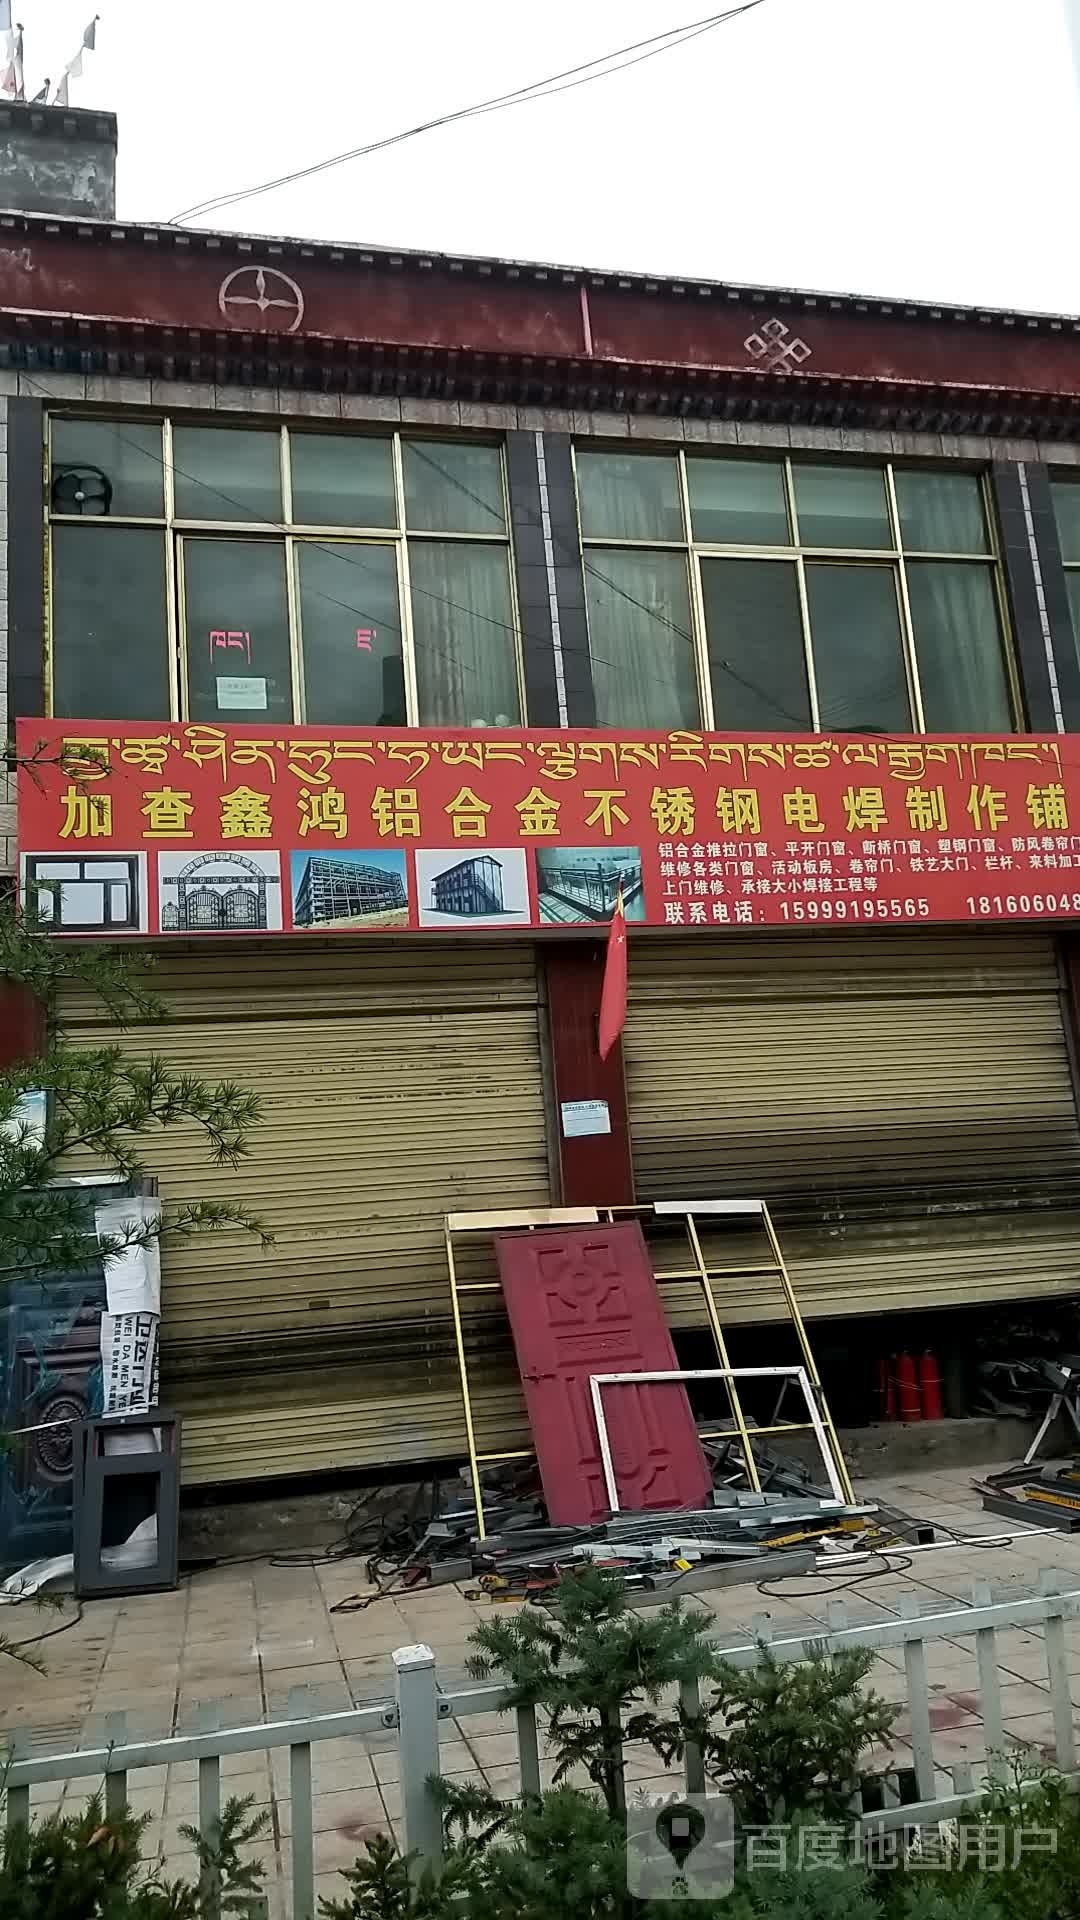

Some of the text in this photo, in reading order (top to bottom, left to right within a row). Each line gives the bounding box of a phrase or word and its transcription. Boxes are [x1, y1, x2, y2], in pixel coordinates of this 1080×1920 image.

[59, 783, 1069, 838] 加查鑫鸿铝合金不锈钢电焊制作铺
[662, 877, 879, 896] 上门维修、承接大小焊接工程等
[780, 898, 931, 922] 15999195565
[118, 1316, 133, 1409] WEI DA MEN YE
